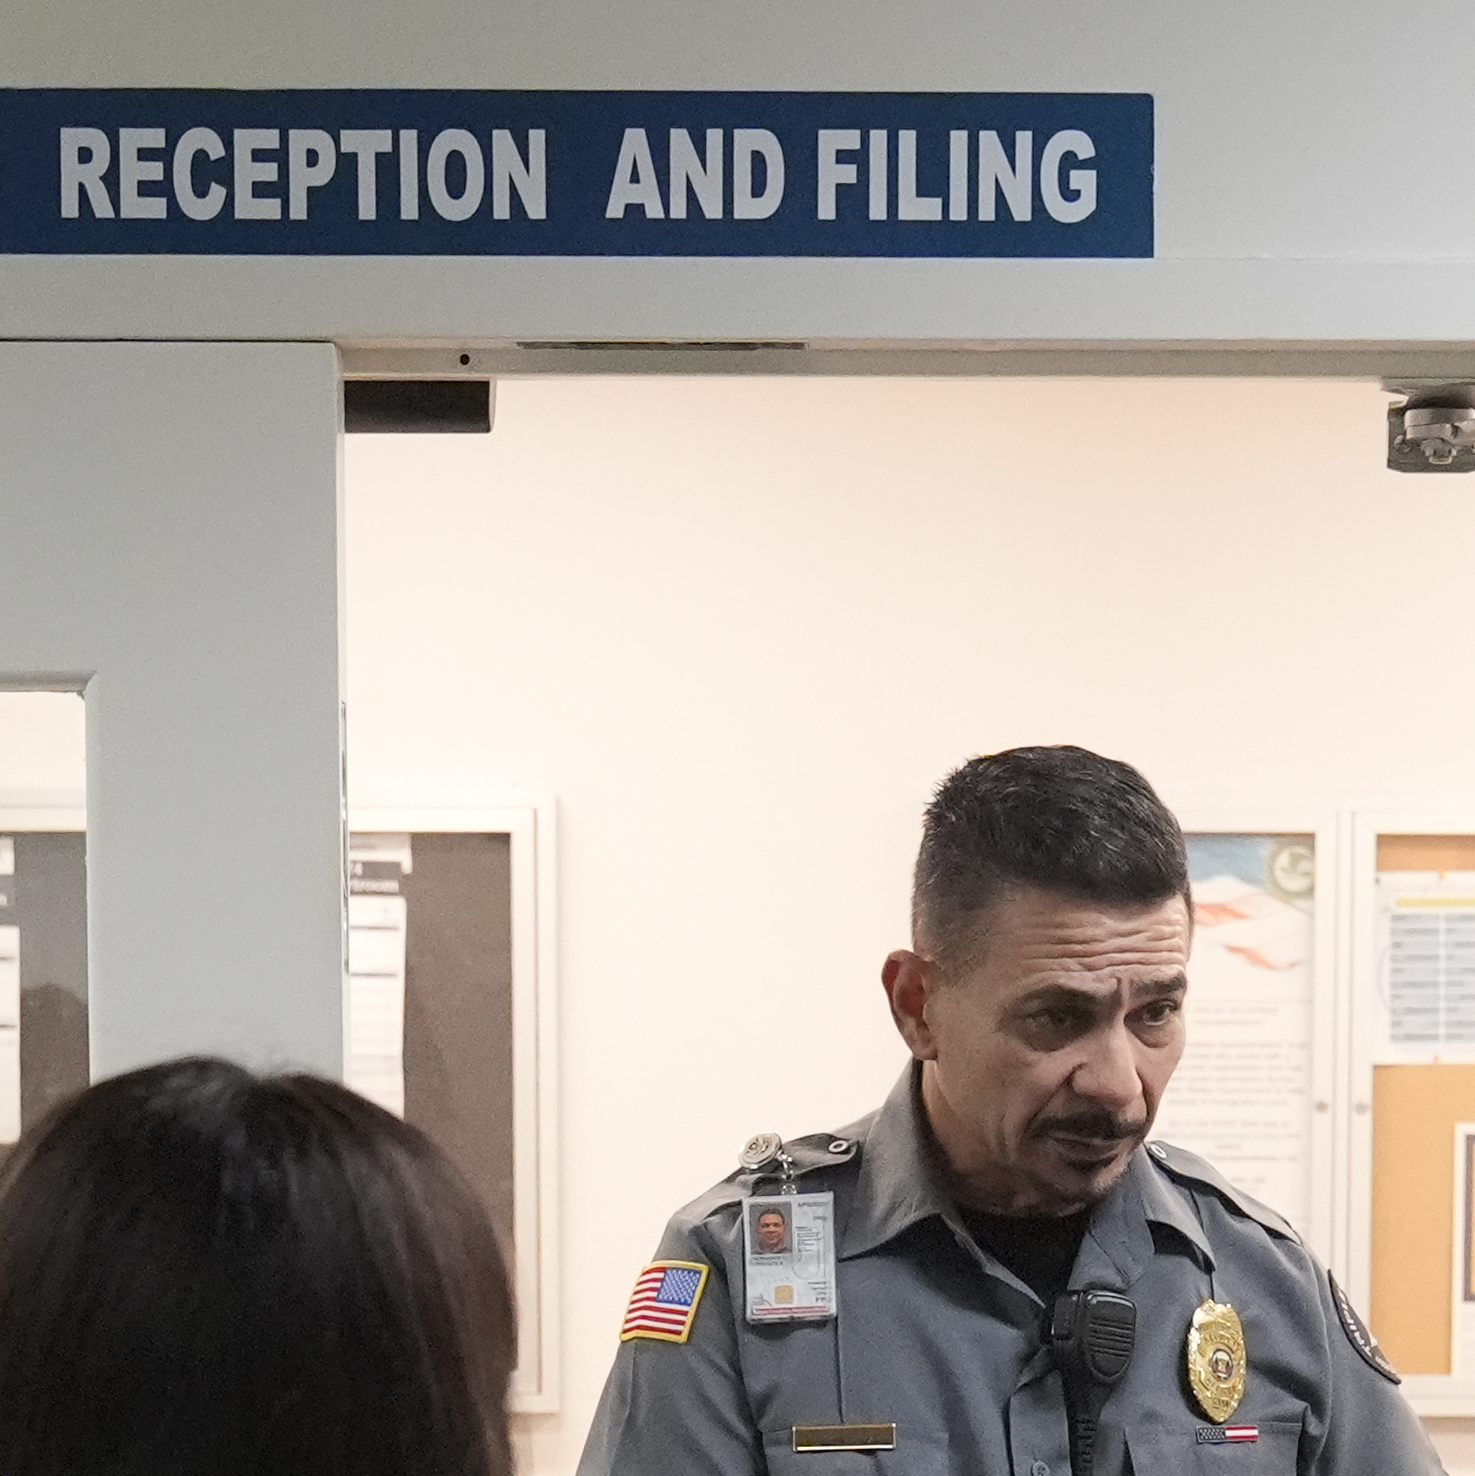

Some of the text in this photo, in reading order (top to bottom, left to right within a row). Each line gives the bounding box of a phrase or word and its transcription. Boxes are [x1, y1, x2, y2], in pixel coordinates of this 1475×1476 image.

[60, 127, 547, 222] RECEPTION
[605, 127, 785, 221] AND
[817, 129, 1098, 224] FILING
